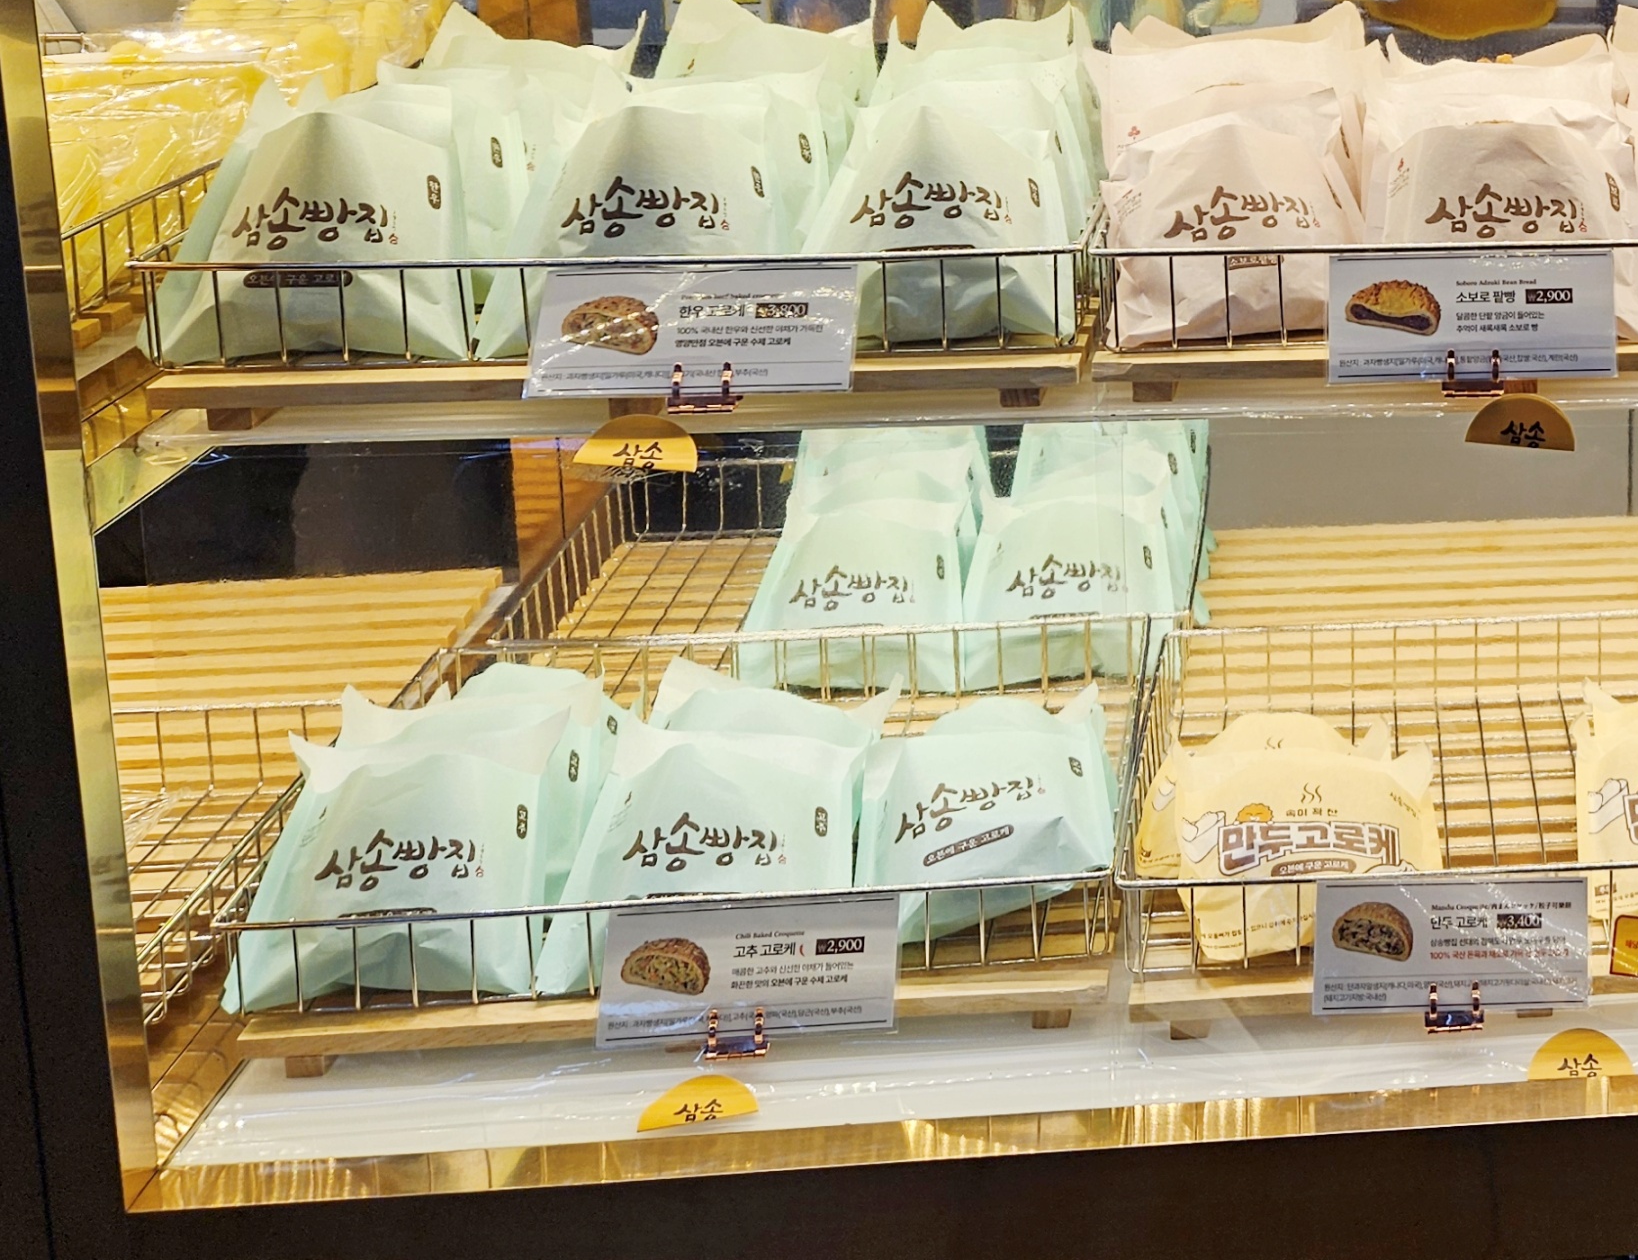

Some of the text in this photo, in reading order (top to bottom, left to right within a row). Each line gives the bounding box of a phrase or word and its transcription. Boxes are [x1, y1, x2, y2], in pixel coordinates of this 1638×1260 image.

[561, 175, 721, 238] 삼송빵집
[850, 171, 1003, 228] 삼송빵집
[1164, 185, 1311, 242] 삼송빵집
[1426, 182, 1578, 239] 삼송빵집
[232, 187, 388, 251] 삼송빵집
[680, 305, 703, 319] 한우
[1456, 290, 1571, 304] 소보로 팥빵 ₩2,900
[733, 338, 749, 347] 구운
[767, 337, 791, 346] 고로케
[1509, 324, 1529, 332] 소보로
[1531, 323, 1539, 331] 빵
[1500, 420, 1546, 448] 삼송
[612, 439, 664, 471] 삼송
[790, 564, 909, 612] 삼송빵집
[1006, 553, 1122, 599] 삼송빵집
[895, 777, 1033, 844] 삼송빵집
[623, 812, 780, 871] 삼송빵집
[926, 825, 1010, 864] 오븐에 구운 고로케
[1221, 823, 1397, 871] 만두고로케
[314, 828, 475, 891] 삼송빵집
[1279, 859, 1349, 875] 오븐에 구운 고로케
[733, 938, 862, 958] 고추 고로케 ₩2,900
[735, 932, 751, 940] Chili
[753, 931, 772, 939] Baked
[1430, 950, 1466, 959] 100% 국산
[732, 967, 754, 976] 매콤한
[779, 964, 801, 974] 신선한
[771, 977, 792, 987] 오븐에
[794, 976, 808, 986] 구운
[810, 975, 824, 984] 수제
[825, 974, 848, 983] 고로케
[1557, 1053, 1602, 1078] 삼송
[673, 1098, 724, 1123] 삼송
